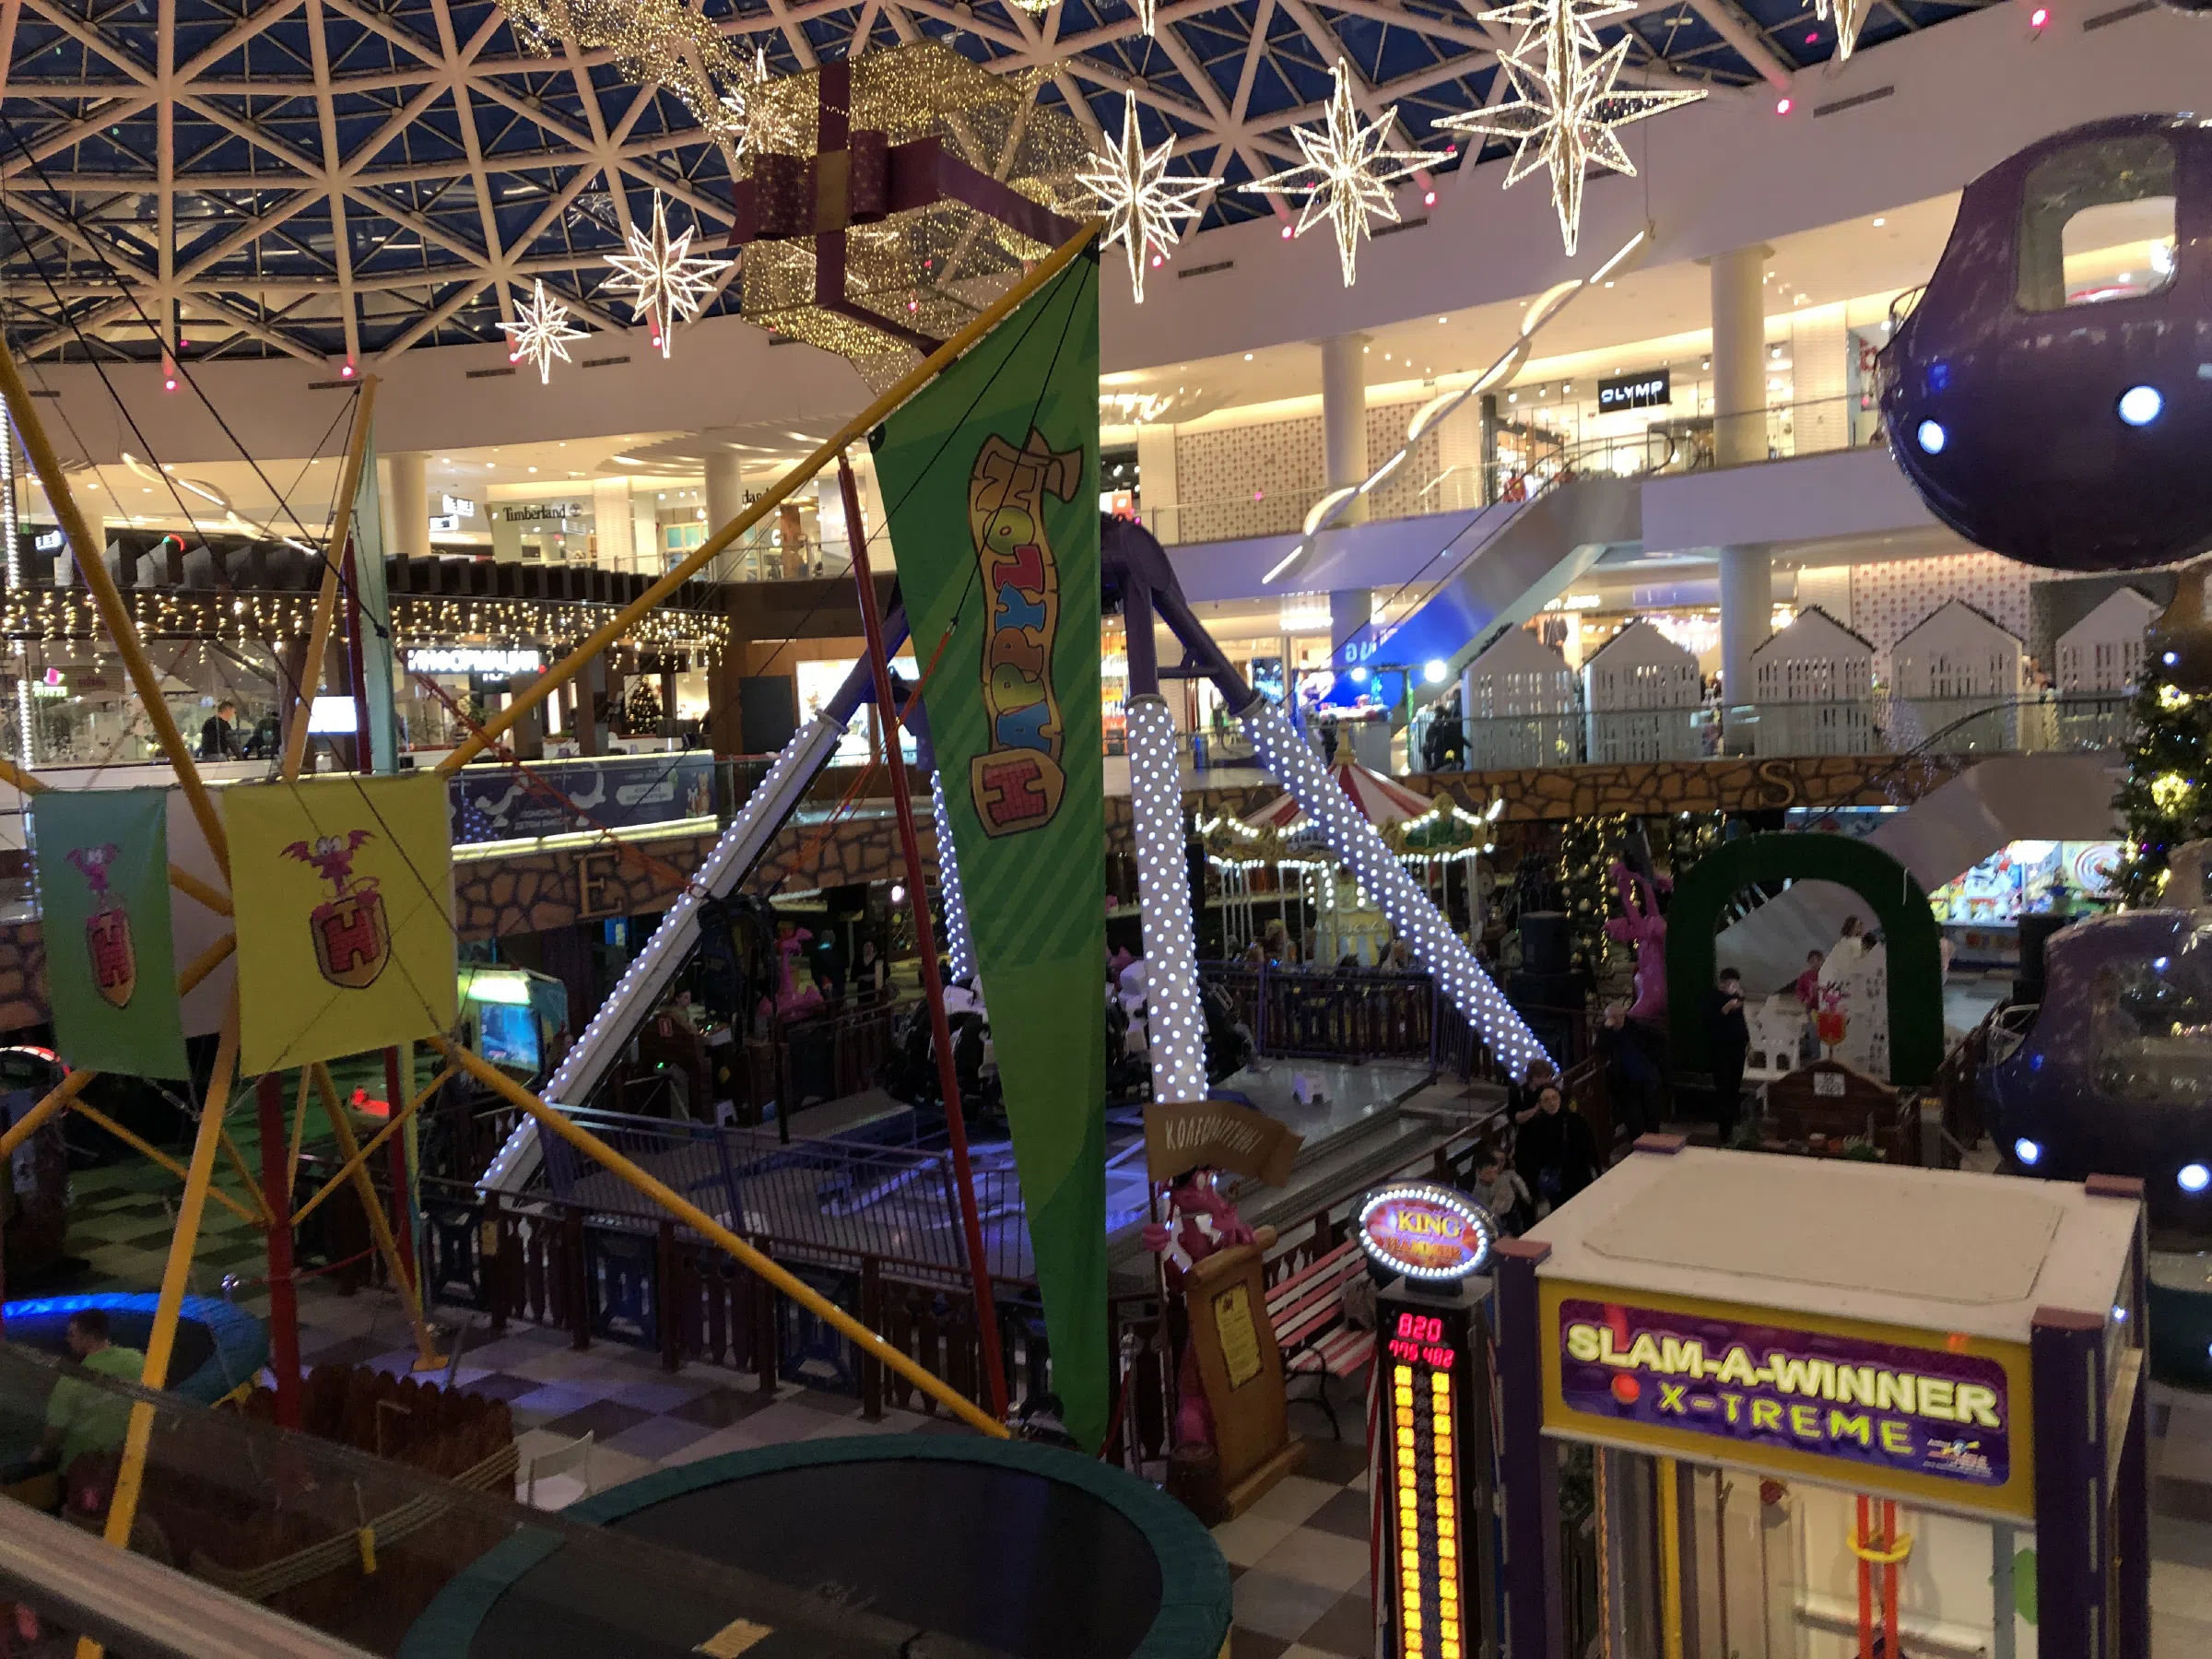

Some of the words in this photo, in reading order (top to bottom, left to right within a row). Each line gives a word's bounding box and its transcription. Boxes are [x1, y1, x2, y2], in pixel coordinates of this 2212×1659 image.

[1601, 380, 1664, 403] OLYMP
[503, 503, 566, 522] Timberland
[975, 450, 1049, 828] HAPPYLON
[1397, 1208, 1462, 1239] KING
[1568, 1324, 2001, 1428] SLAM-A-WINNER
[1660, 1382, 1913, 1454] X-TREME
